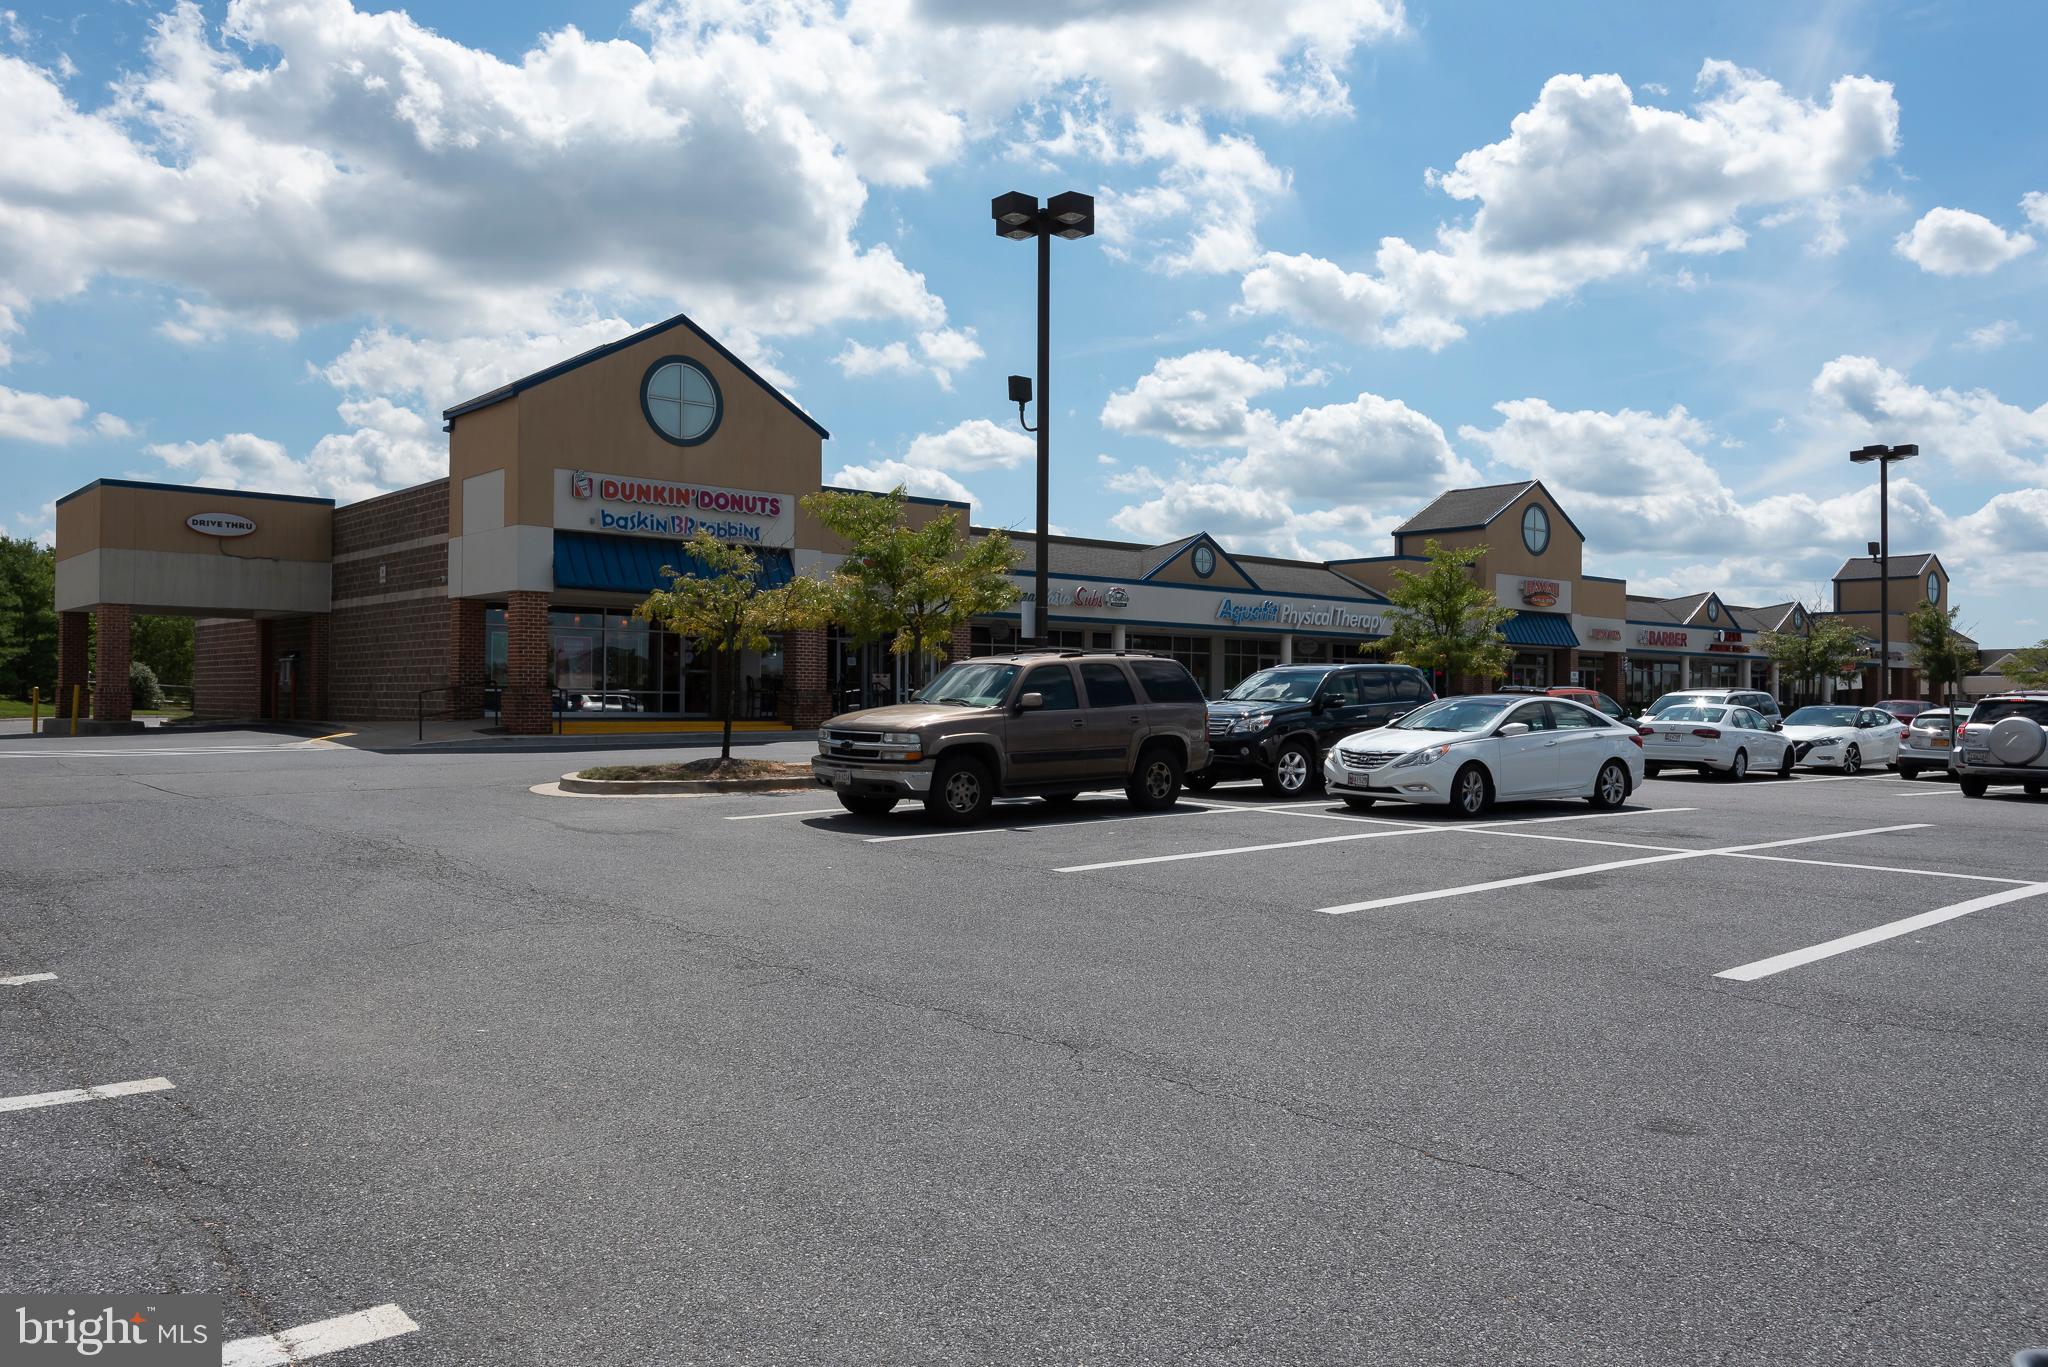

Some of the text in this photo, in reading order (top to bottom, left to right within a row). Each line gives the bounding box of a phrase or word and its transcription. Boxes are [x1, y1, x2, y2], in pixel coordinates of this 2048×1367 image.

[602, 479, 782, 517] DUNKIN' DONUTS
[191, 518, 253, 530] DRIVE THRU
[1073, 585, 1104, 609] Subs
[1280, 603, 1334, 629] Physical
[1335, 607, 1387, 633] Therapy
[1648, 630, 1688, 648] BARBER
